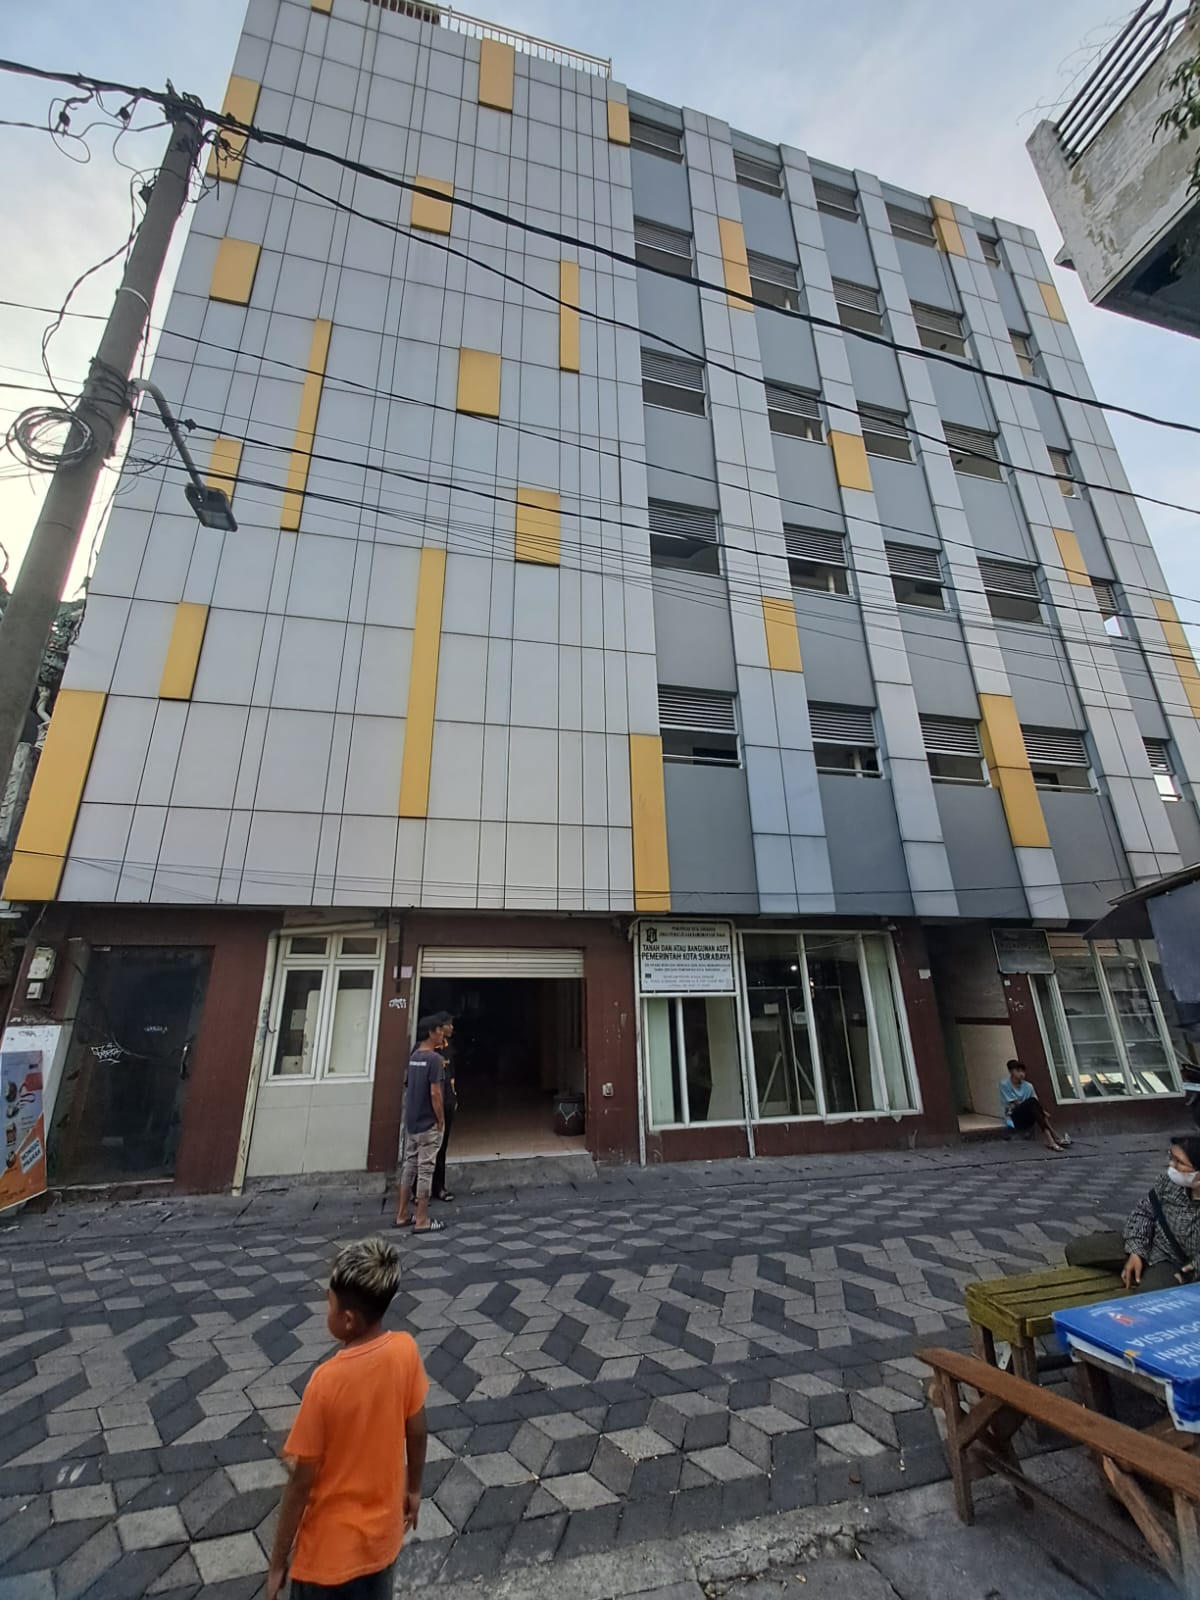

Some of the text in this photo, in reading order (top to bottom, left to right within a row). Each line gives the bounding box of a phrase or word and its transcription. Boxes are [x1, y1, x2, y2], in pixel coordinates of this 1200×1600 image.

[642, 952, 730, 961] PEMERINTAH KOTA SURABAYA
